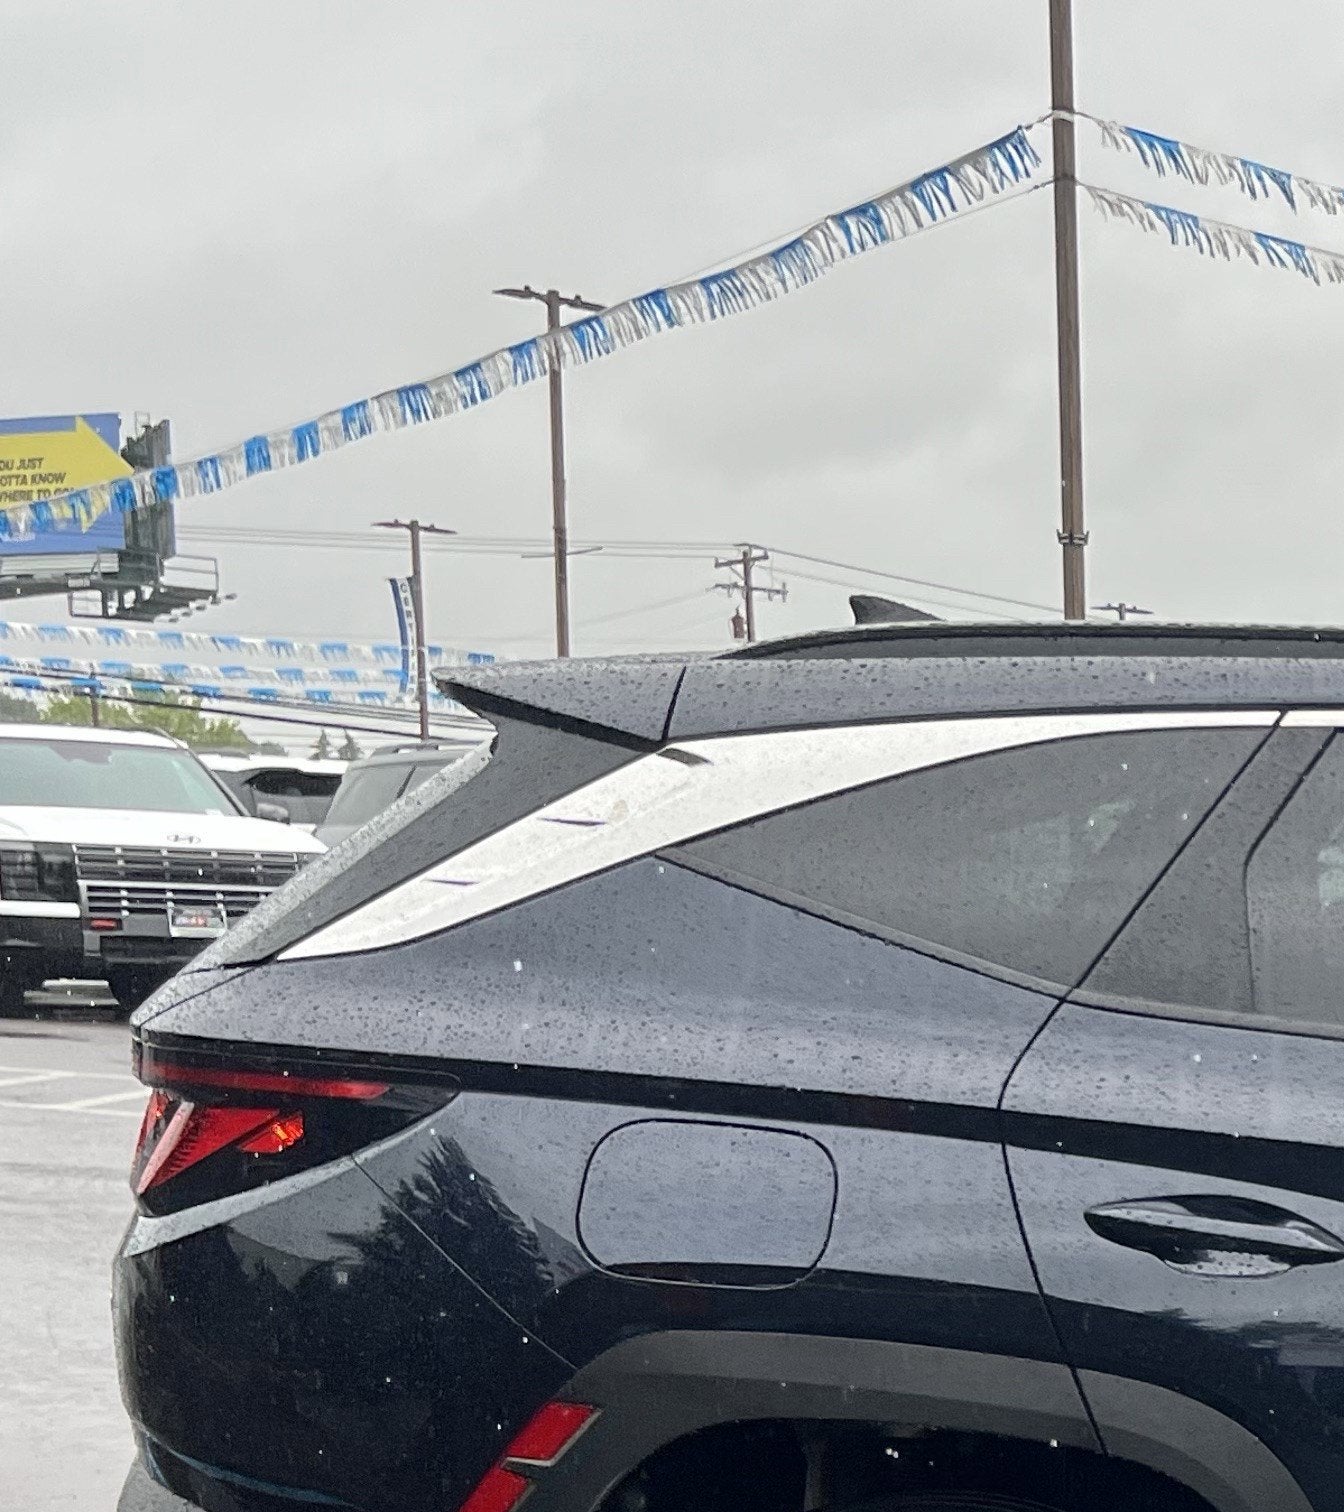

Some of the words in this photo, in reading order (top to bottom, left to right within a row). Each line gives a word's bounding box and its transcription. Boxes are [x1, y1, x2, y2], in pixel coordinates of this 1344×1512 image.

[0, 459, 14, 471] OU
[17, 457, 44, 470] JUST
[0, 474, 28, 486] OTTA
[31, 472, 67, 485] KNOW
[0, 490, 34, 502] HERE
